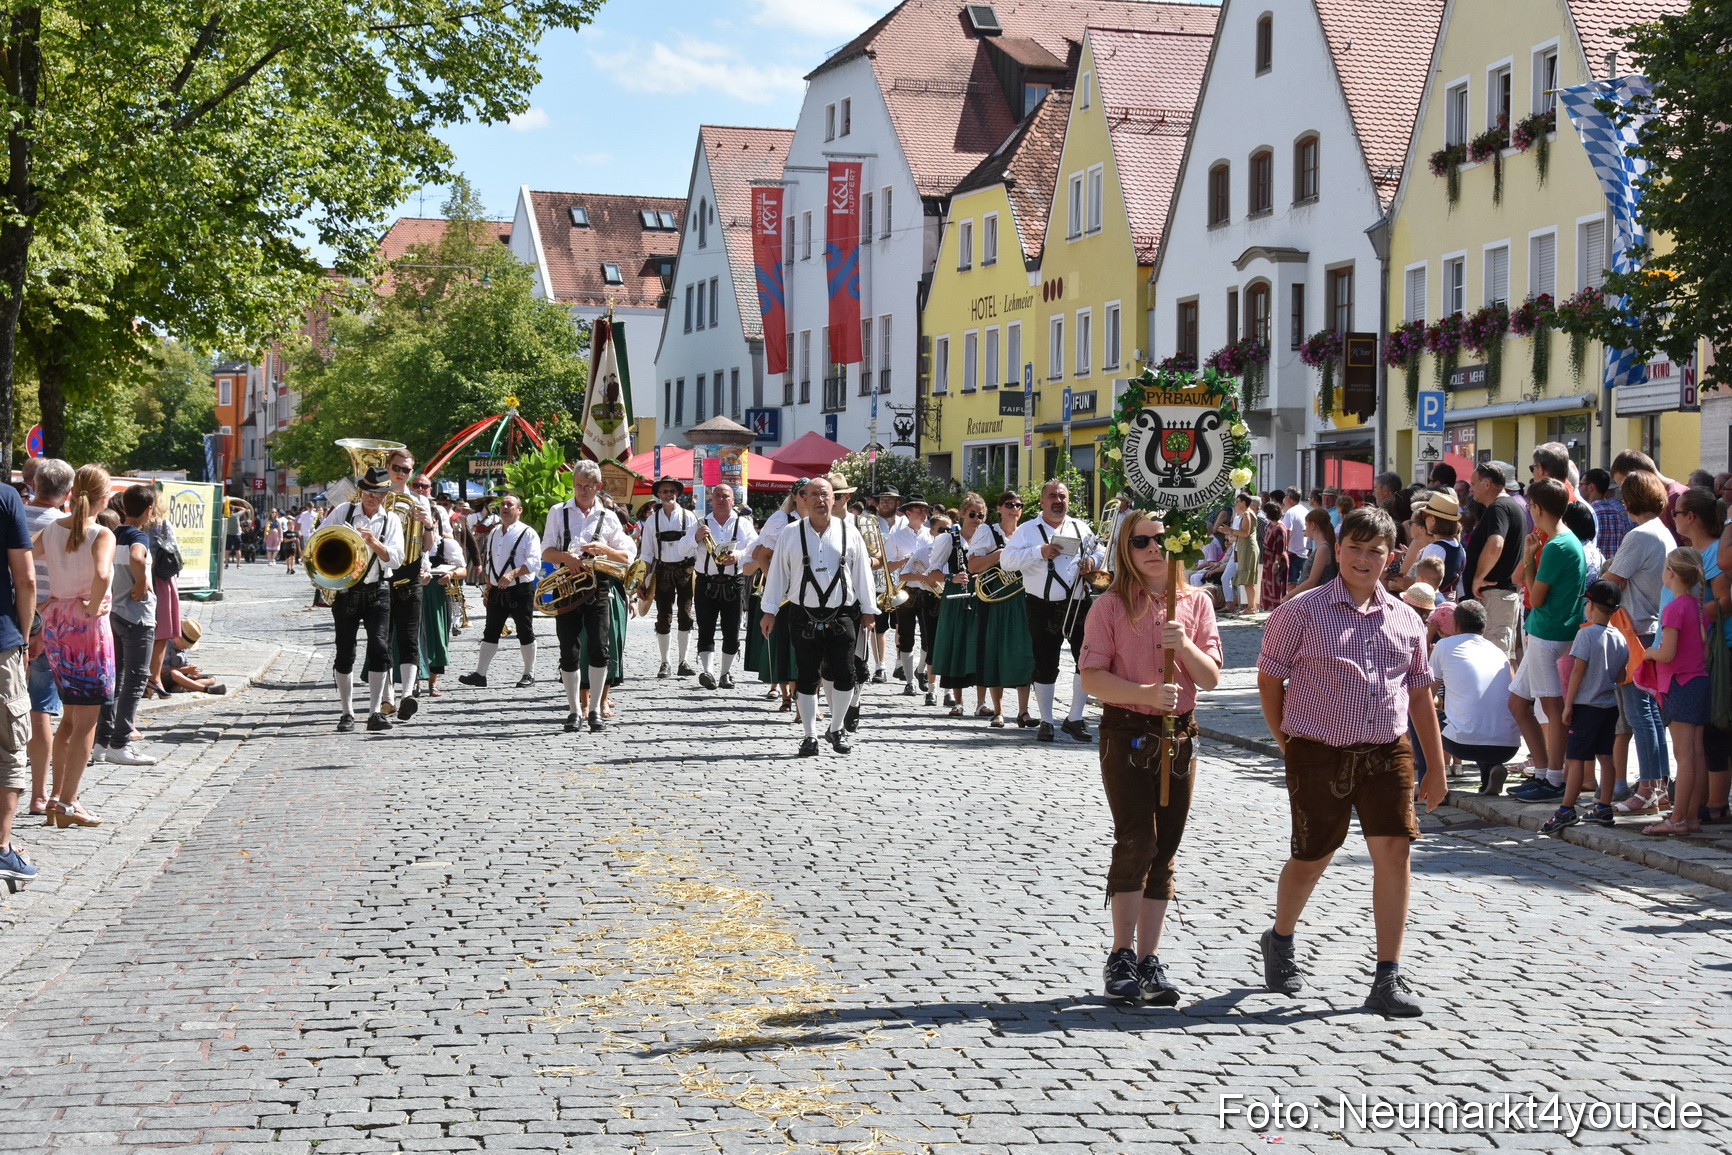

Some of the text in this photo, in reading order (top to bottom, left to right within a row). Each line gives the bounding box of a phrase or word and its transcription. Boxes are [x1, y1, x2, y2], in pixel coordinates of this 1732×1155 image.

[832, 168, 849, 214] K&L
[971, 291, 1034, 321] HOTEL Lehmeier
[1652, 362, 1670, 379] KINO
[1684, 350, 1695, 404] INO
[1064, 392, 1070, 418] P
[1145, 391, 1214, 406] PYRBAUM
[1424, 396, 1439, 427] P
[966, 417, 1004, 435] Restaurant
[1125, 426, 1158, 500] MUSIKVEREIN
[1158, 491, 1179, 508] DER
[255, 480, 263, 489] T
[169, 495, 206, 529] BOGNER
